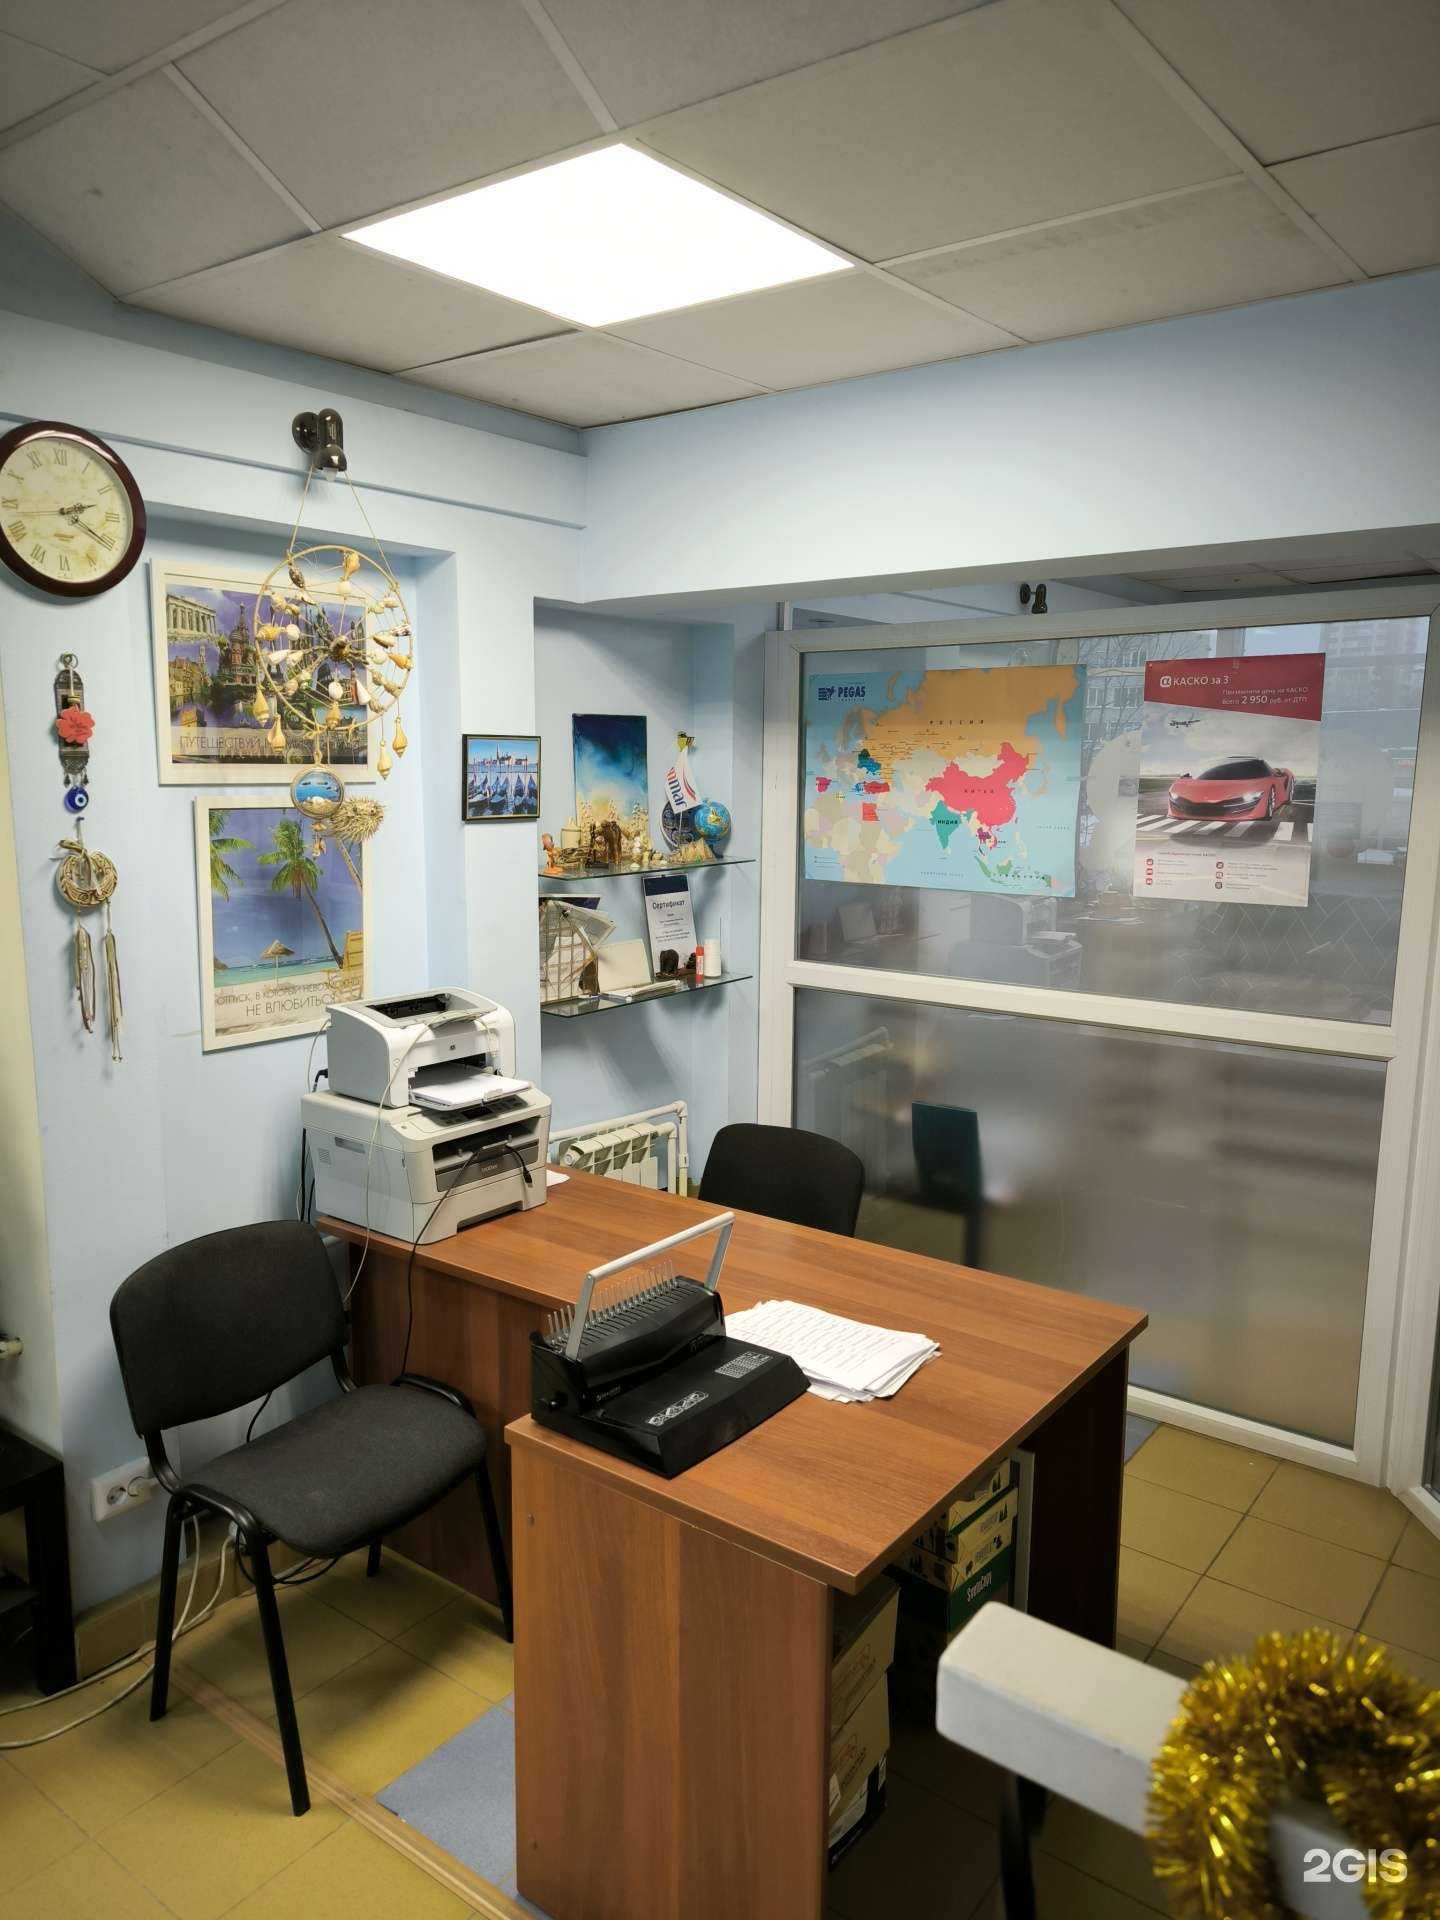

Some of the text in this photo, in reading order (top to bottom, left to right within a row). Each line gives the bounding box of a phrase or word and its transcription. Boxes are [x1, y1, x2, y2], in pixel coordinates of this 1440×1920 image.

[1174, 676, 1208, 686] КАСКО
[837, 686, 866, 698] PEGAS
[1249, 695, 1268, 703] 950
[652, 900, 685, 910] Сертификат
[246, 993, 336, 1016] НЕ ВЛЮБИТЬСЯ
